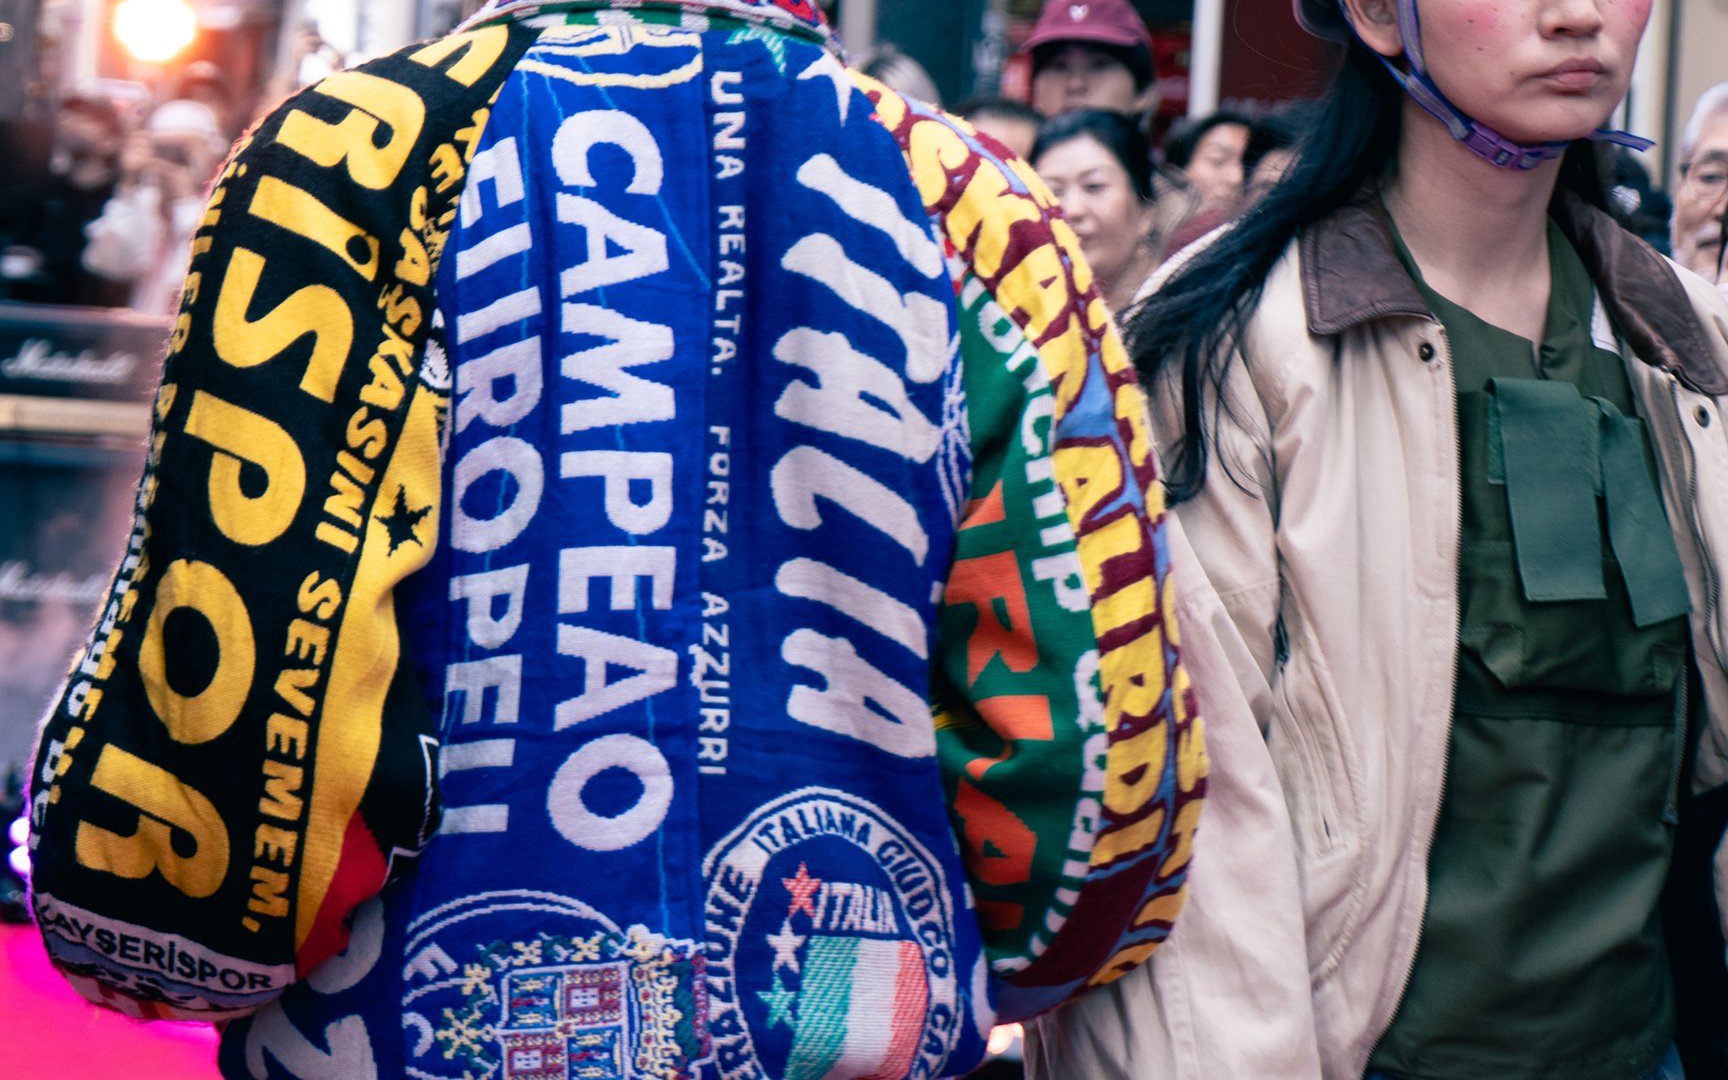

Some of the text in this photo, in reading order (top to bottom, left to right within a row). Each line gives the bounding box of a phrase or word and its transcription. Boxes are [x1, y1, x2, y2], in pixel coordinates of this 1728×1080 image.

[710, 71, 746, 180] UNA
[702, 425, 732, 563] FORZA
[770, 153, 949, 758] ITALIA
[698, 592, 732, 776] AZZURRI
[812, 881, 900, 934] ITALIA
